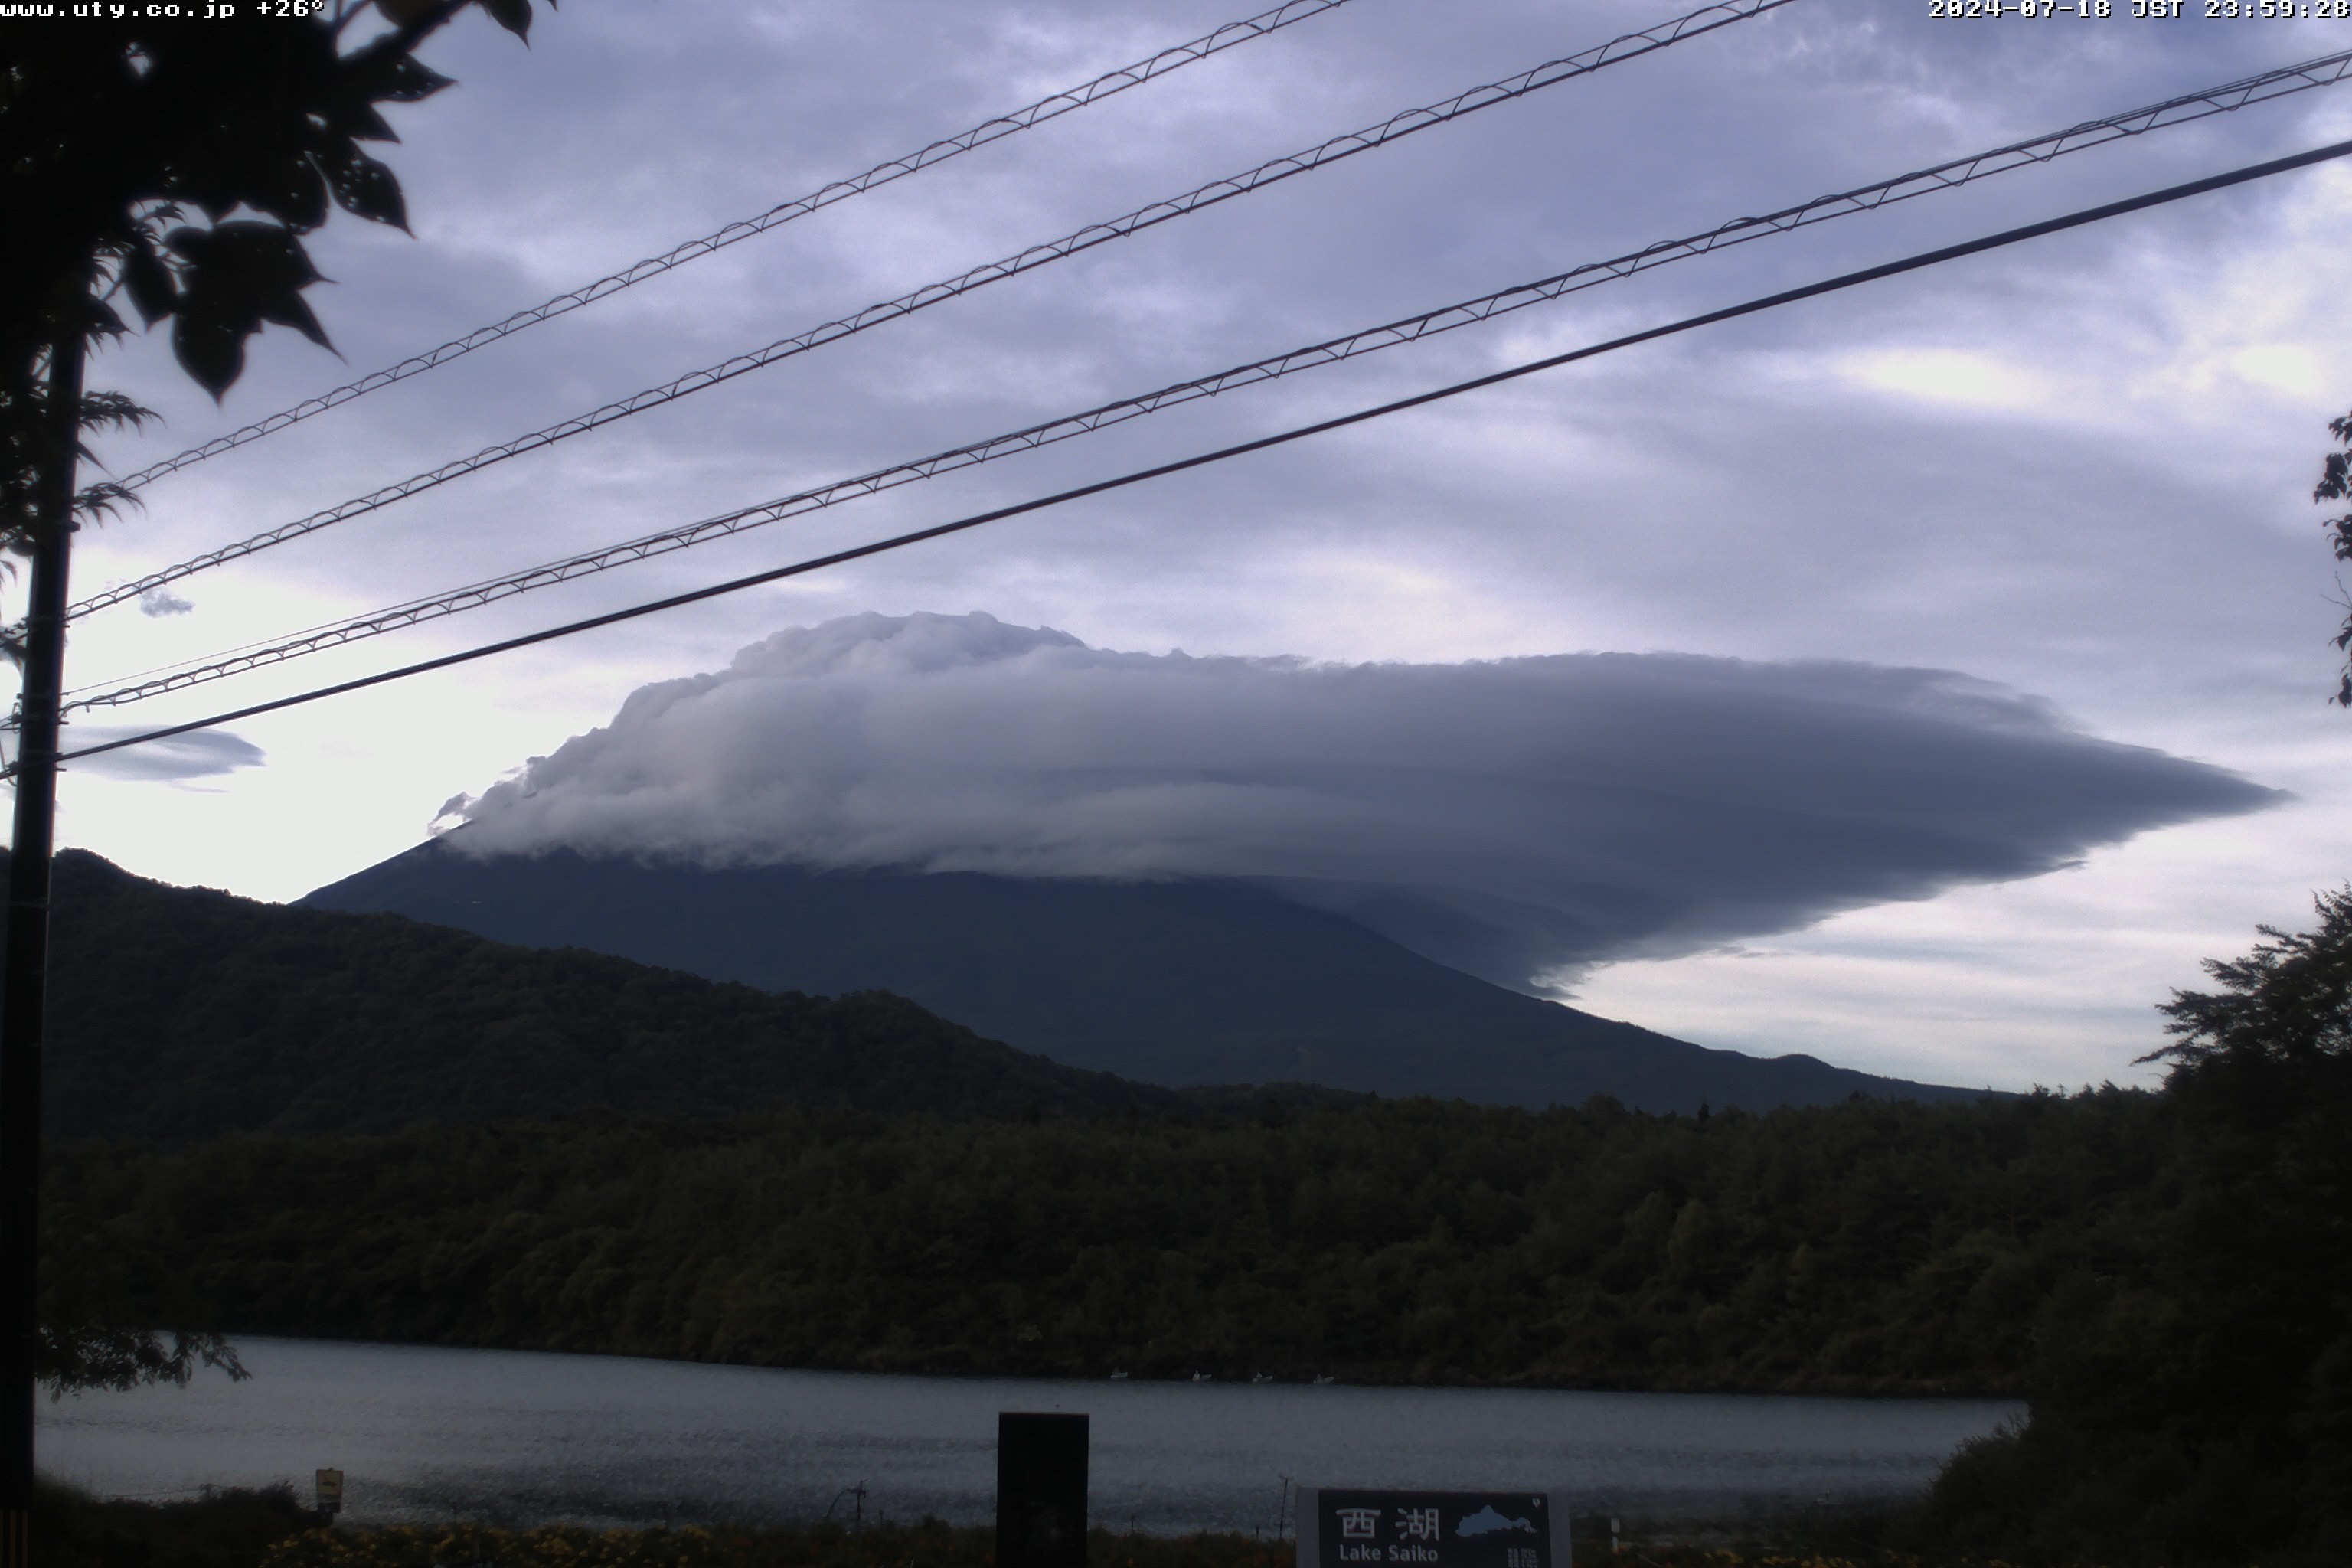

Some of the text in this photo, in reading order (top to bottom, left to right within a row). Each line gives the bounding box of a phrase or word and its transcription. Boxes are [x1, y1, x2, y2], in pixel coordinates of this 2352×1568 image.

[1335, 1508, 1440, 1541] 西湖
[1340, 1544, 1439, 1562] Lake Saiko
